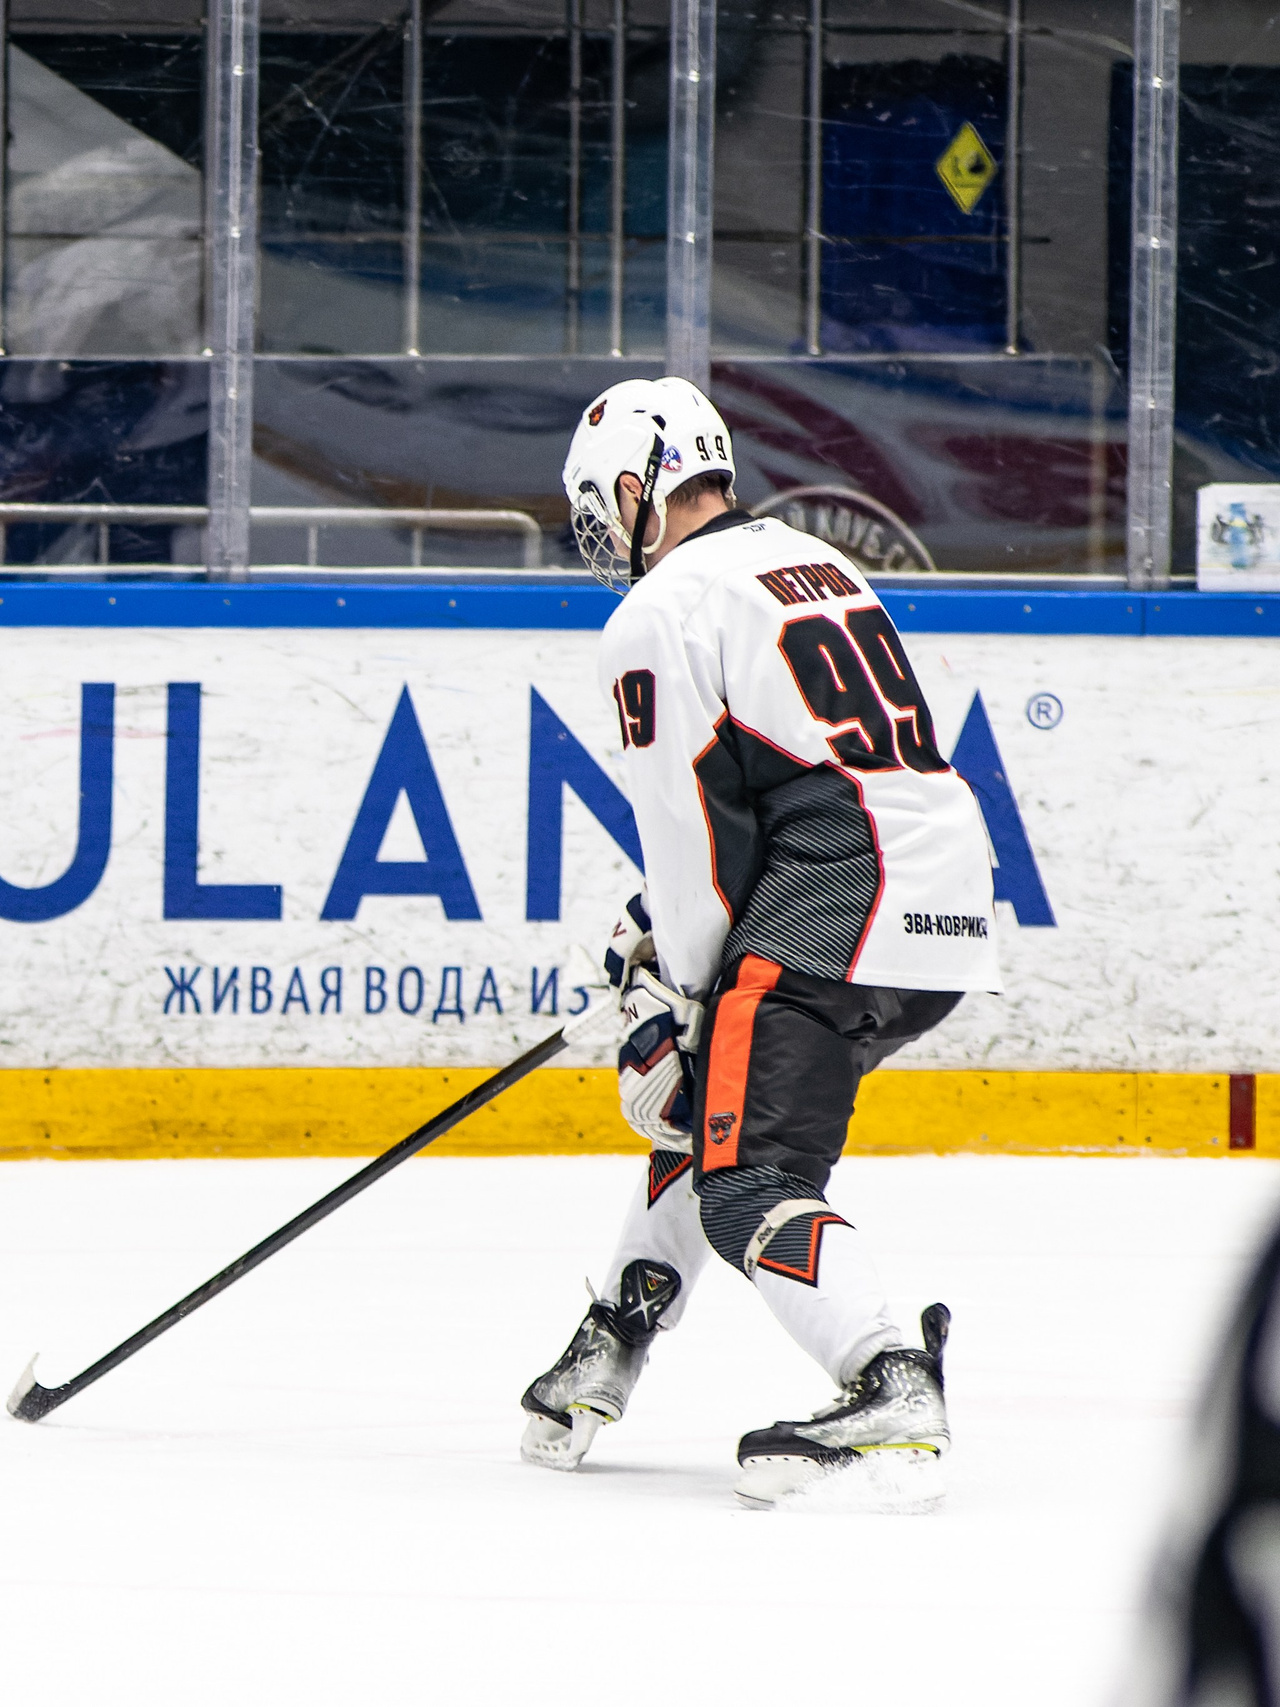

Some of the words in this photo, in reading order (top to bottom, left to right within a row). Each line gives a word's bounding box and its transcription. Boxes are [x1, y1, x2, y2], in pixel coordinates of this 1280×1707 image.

[755, 562, 863, 607] ПЕТРОВ
[777, 604, 951, 775] 99
[163, 966, 343, 1015] ЖИВАЯ
[364, 966, 504, 1025] ВОДА
